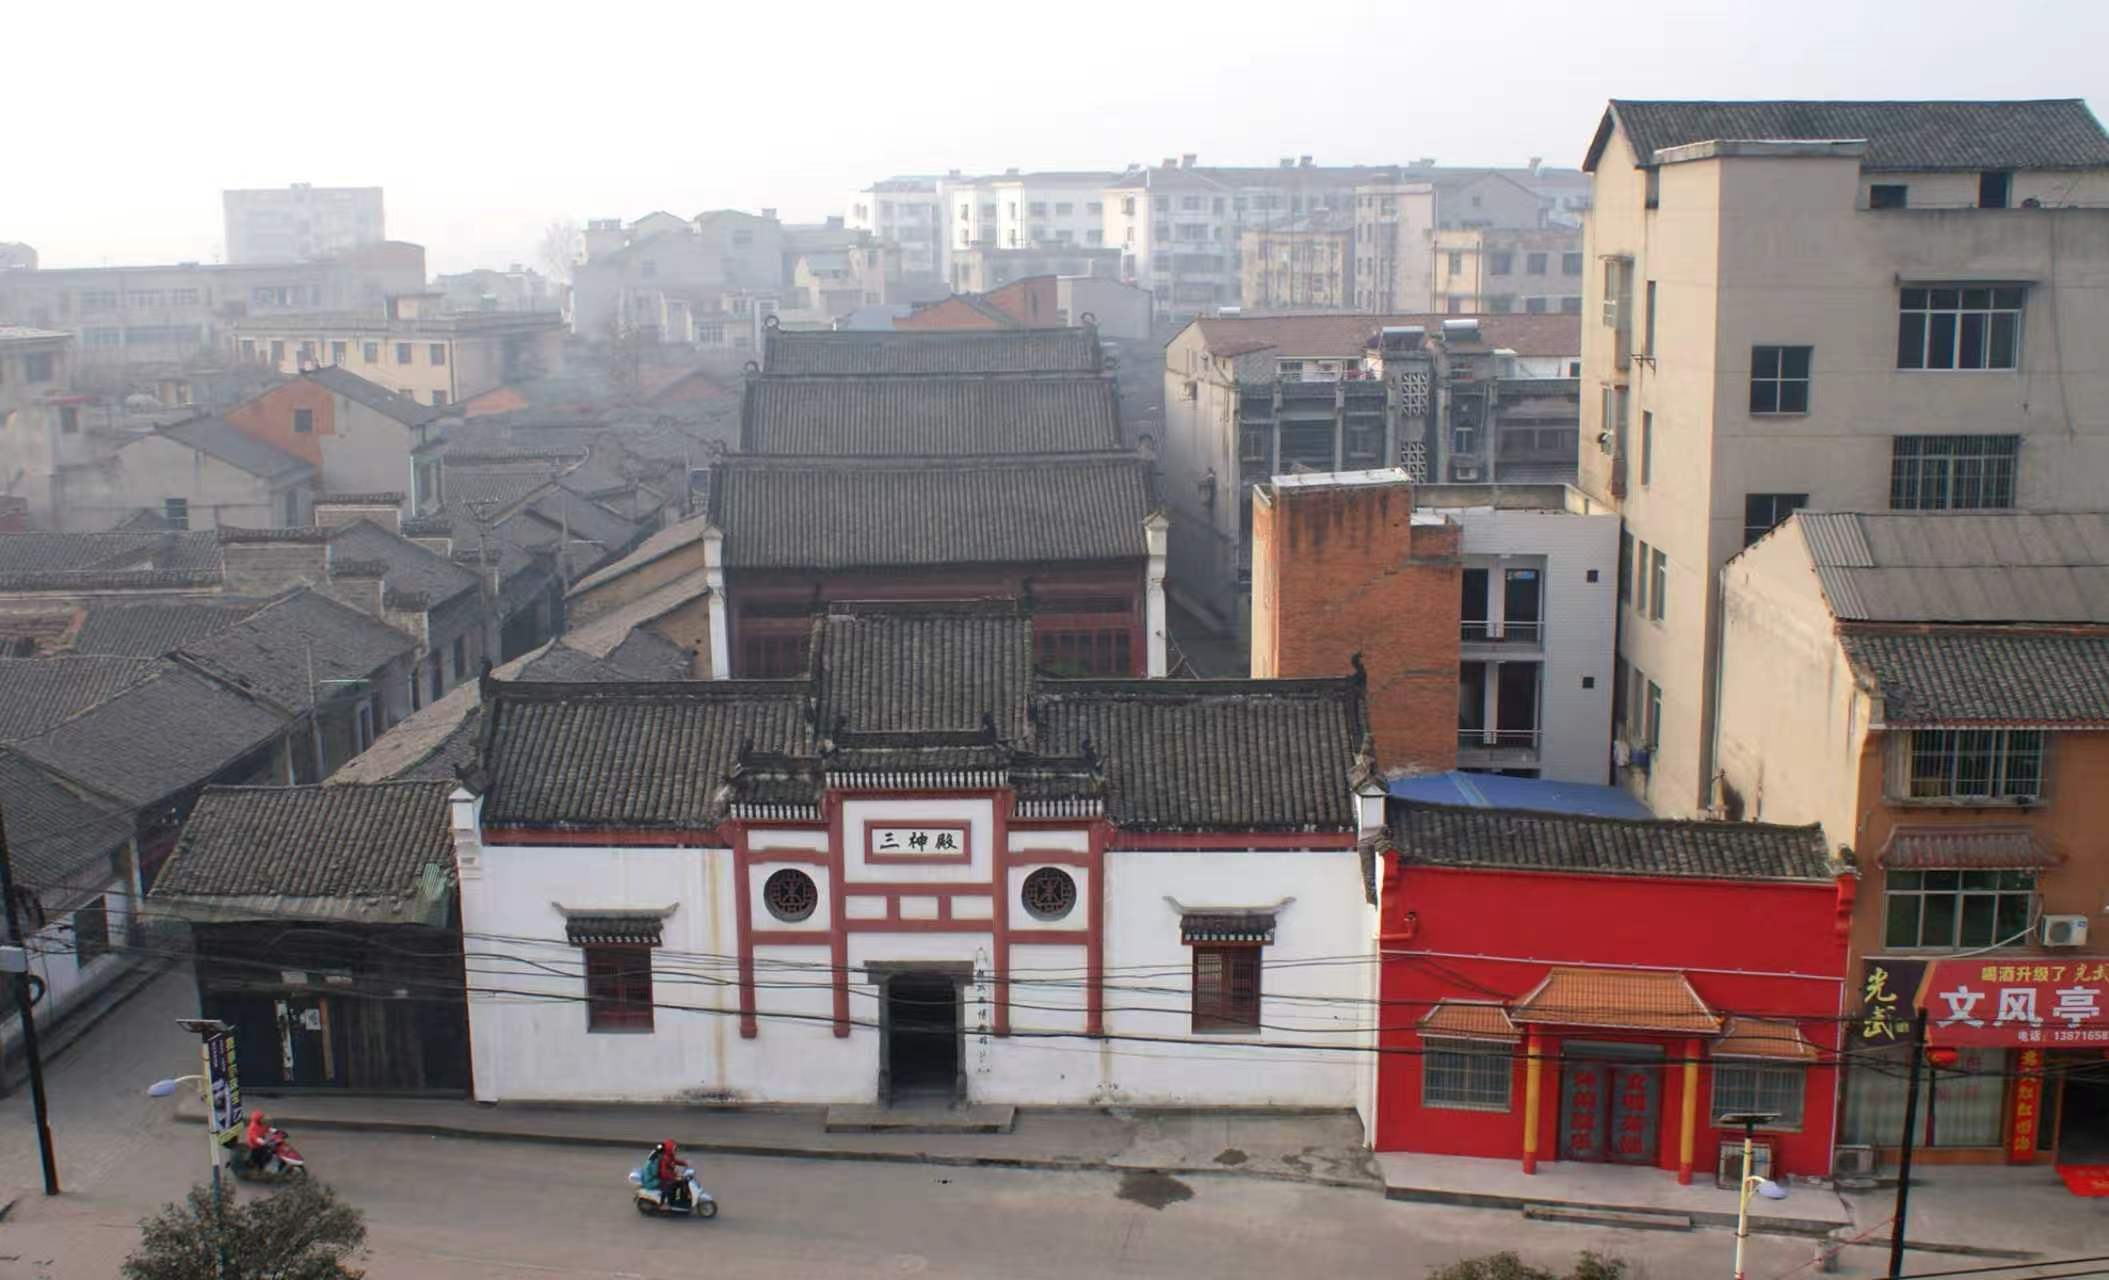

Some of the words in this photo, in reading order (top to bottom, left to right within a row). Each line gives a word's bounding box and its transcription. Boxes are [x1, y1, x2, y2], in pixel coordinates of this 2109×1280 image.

[879, 831, 959, 852] 三神殿
[1981, 966, 2066, 982] 喝酒升级了
[1863, 966, 1898, 1040] 光武
[1936, 985, 2101, 1028] 文风亭
